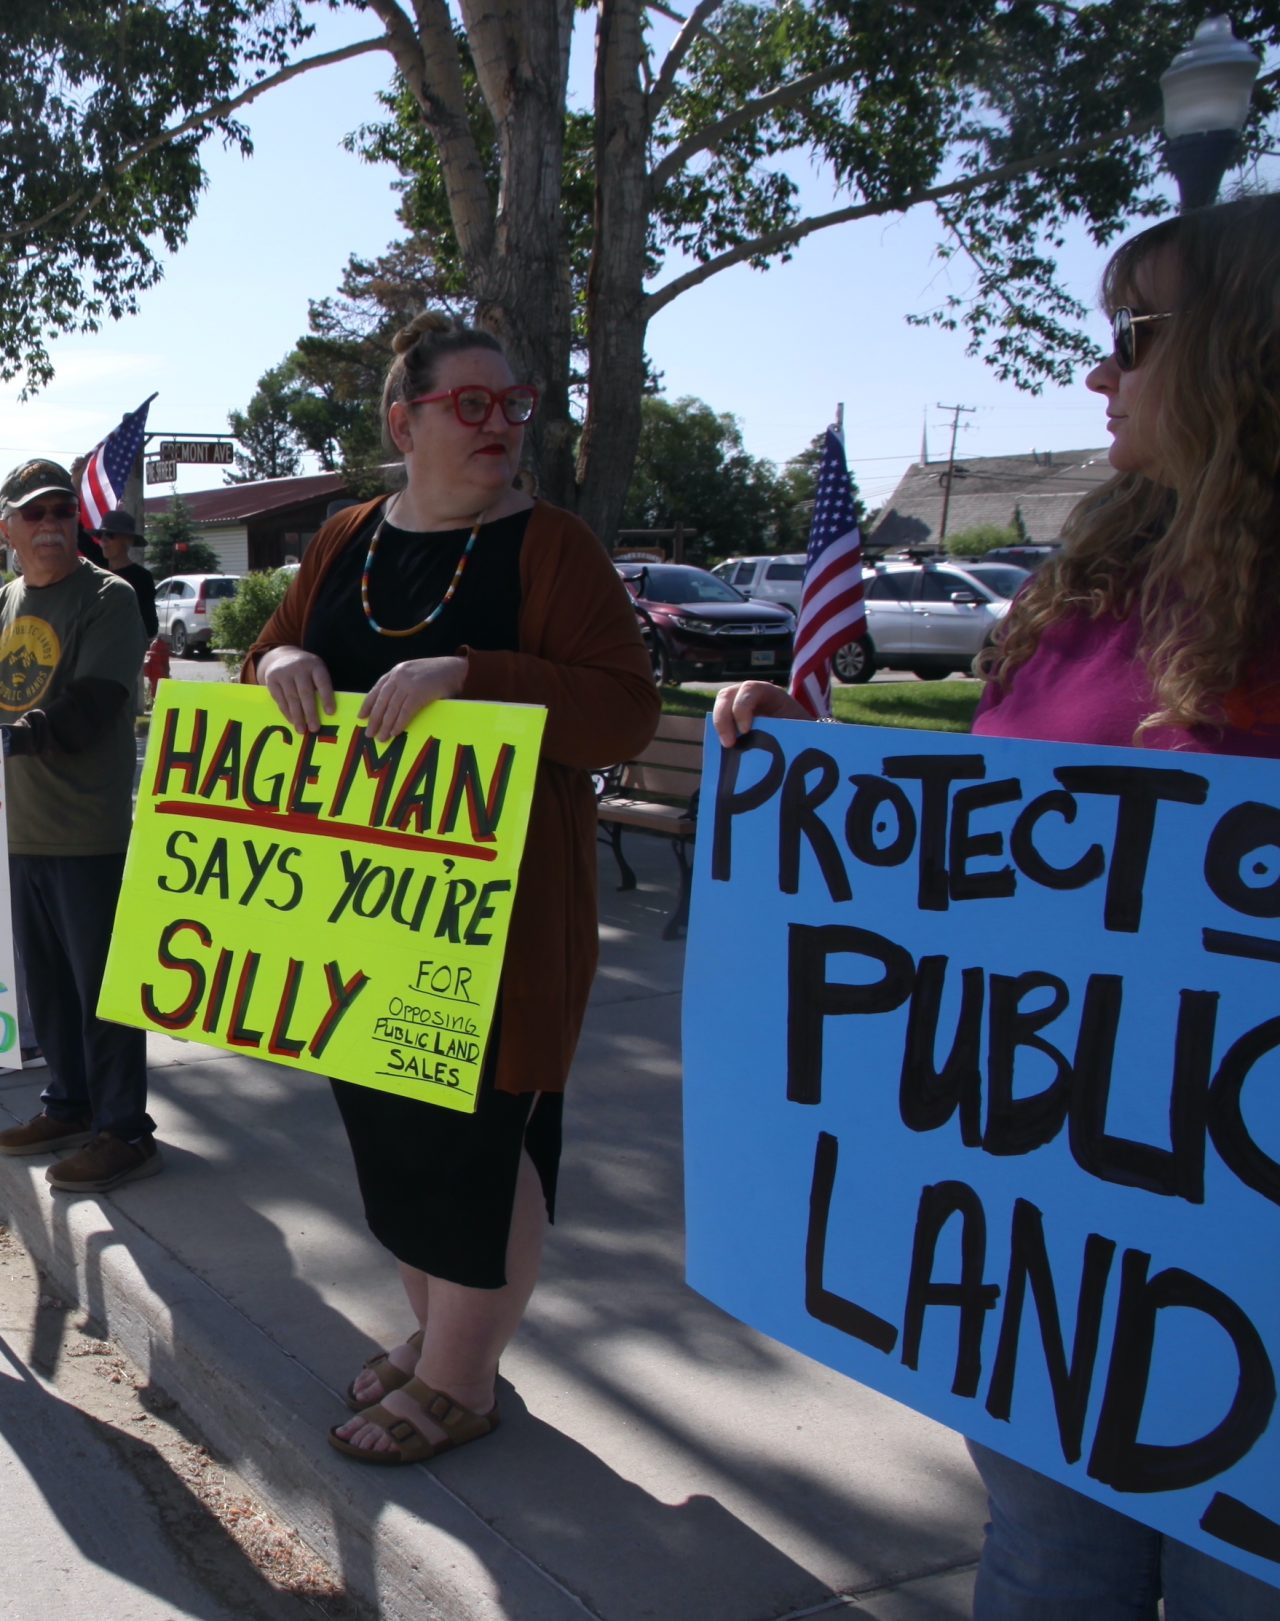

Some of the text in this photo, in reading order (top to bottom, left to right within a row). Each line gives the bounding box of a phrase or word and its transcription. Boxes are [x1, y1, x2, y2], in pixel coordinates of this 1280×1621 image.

[161, 443, 232, 462] FREMONT AVE
[152, 708, 516, 843] HAGEMAN
[710, 729, 1210, 933] PROTECT
[157, 830, 511, 946] SAYS YOU'RE
[140, 918, 371, 1059] SILLY
[415, 961, 471, 1000] FOR
[374, 1017, 480, 1062] PUBLIC LAND
[387, 1049, 460, 1087] SALES
